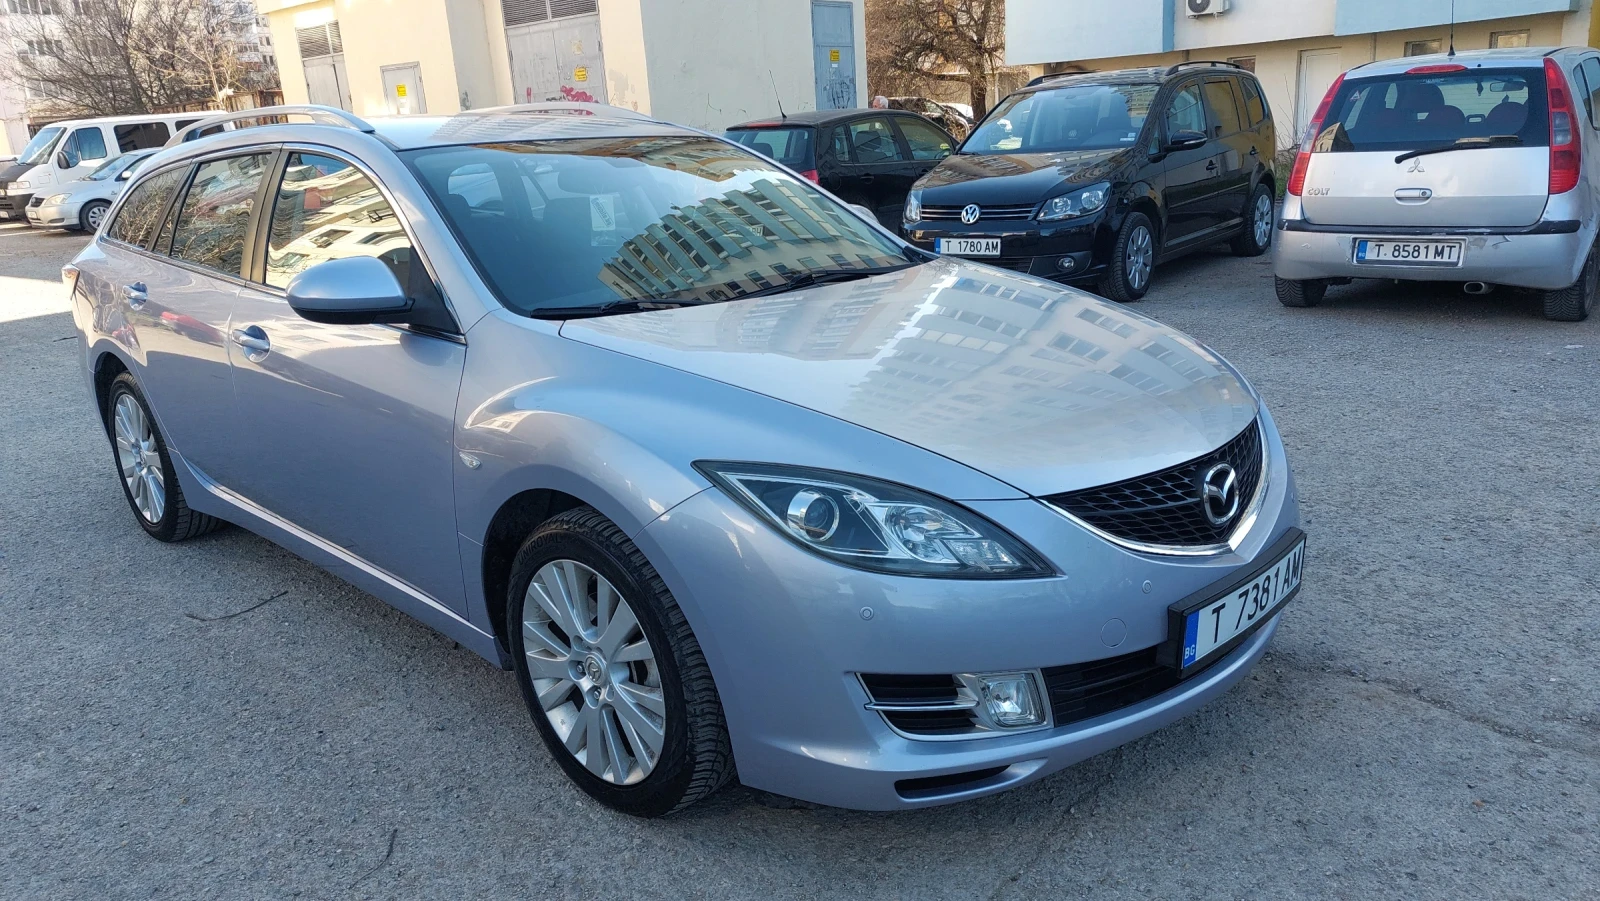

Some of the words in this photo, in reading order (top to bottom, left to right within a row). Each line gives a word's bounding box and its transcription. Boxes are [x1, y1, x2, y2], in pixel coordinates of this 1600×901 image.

[1308, 187, 1331, 196] COLT
[945, 240, 952, 252] T
[958, 240, 982, 253] 1780
[984, 240, 999, 253] AM
[1391, 244, 1430, 259] 8581
[1434, 244, 1457, 260] MT
[518, 533, 562, 565] UNIROYAL
[1211, 602, 1226, 644] T
[1235, 566, 1280, 631] 7381
[1281, 546, 1302, 595] AM
[1184, 644, 1196, 659] BG
